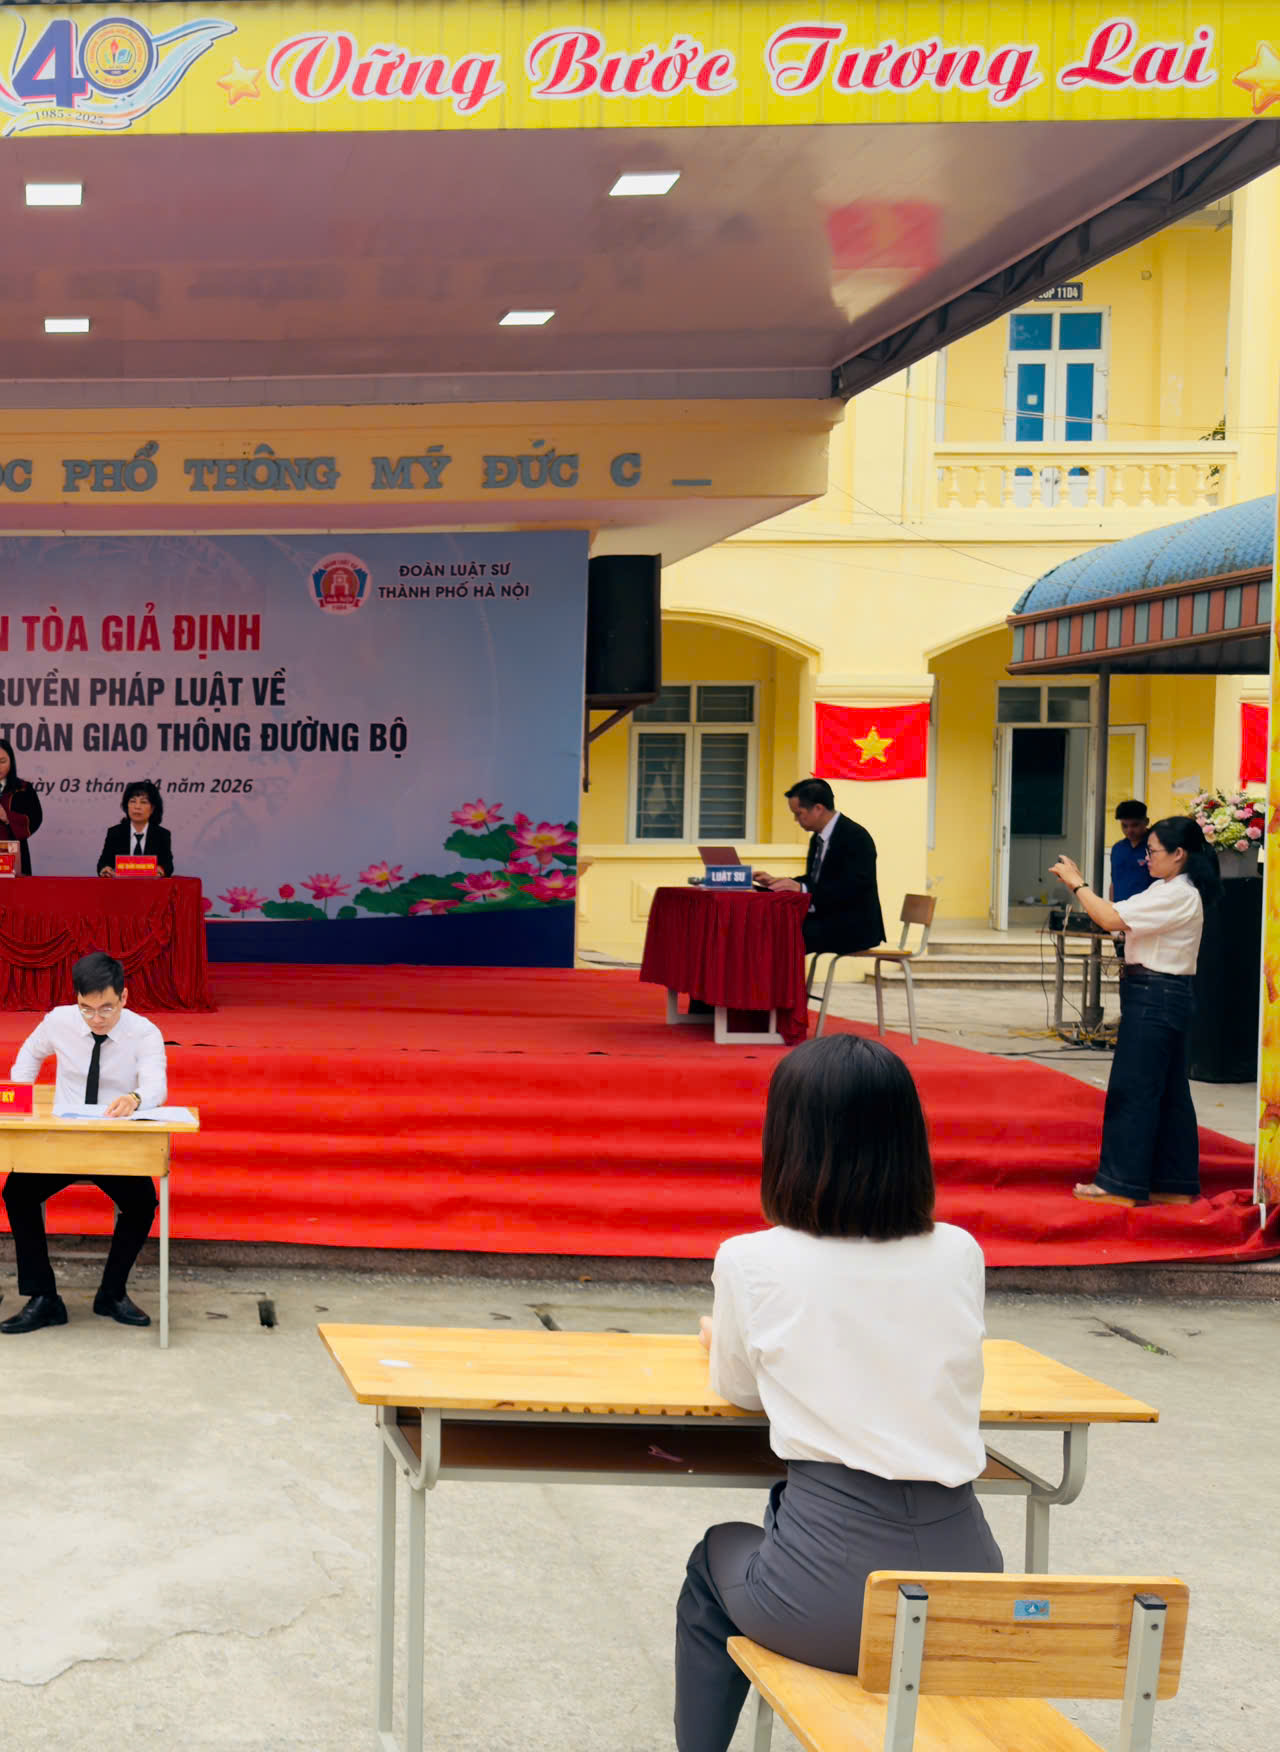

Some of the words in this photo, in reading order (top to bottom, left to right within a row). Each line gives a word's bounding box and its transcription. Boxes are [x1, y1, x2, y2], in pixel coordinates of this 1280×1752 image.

[11, 16, 155, 109] 40
[270, 35, 503, 111] Vững
[529, 31, 734, 95] Bước
[768, 26, 1039, 102] Tương
[1061, 21, 1213, 86] Lai
[35, 108, 65, 121] 1985
[75, 111, 104, 125] 2025
[62, 440, 160, 492] PHỔ
[183, 443, 341, 491] THÔNG
[370, 444, 452, 490] MỸ
[481, 439, 579, 488] ĐỨC
[609, 452, 642, 488] C
[378, 583, 431, 599] THÀNH
[435, 581, 469, 598] PHỐ
[474, 581, 495, 598] HÀ
[501, 581, 529, 600] NỘI
[399, 562, 446, 577] ĐOÀN
[450, 561, 486, 579] LUẬT
[491, 562, 511, 576] SƯ
[21, 606, 89, 652] TÒA
[101, 602, 161, 652] GIẢ
[172, 614, 261, 660] ĐỊNH
[89, 670, 165, 706] PHÁP
[175, 672, 243, 713] LUẬT
[252, 667, 287, 706] VỀ
[0, 716, 73, 752] TOÀN
[83, 722, 149, 752] GIAO
[157, 717, 251, 752] THÔNG
[260, 716, 359, 752] ĐƯỜNG
[370, 717, 408, 759] BỘ
[60, 778, 81, 793] 03
[167, 778, 205, 793] năm
[210, 778, 253, 793] 2026
